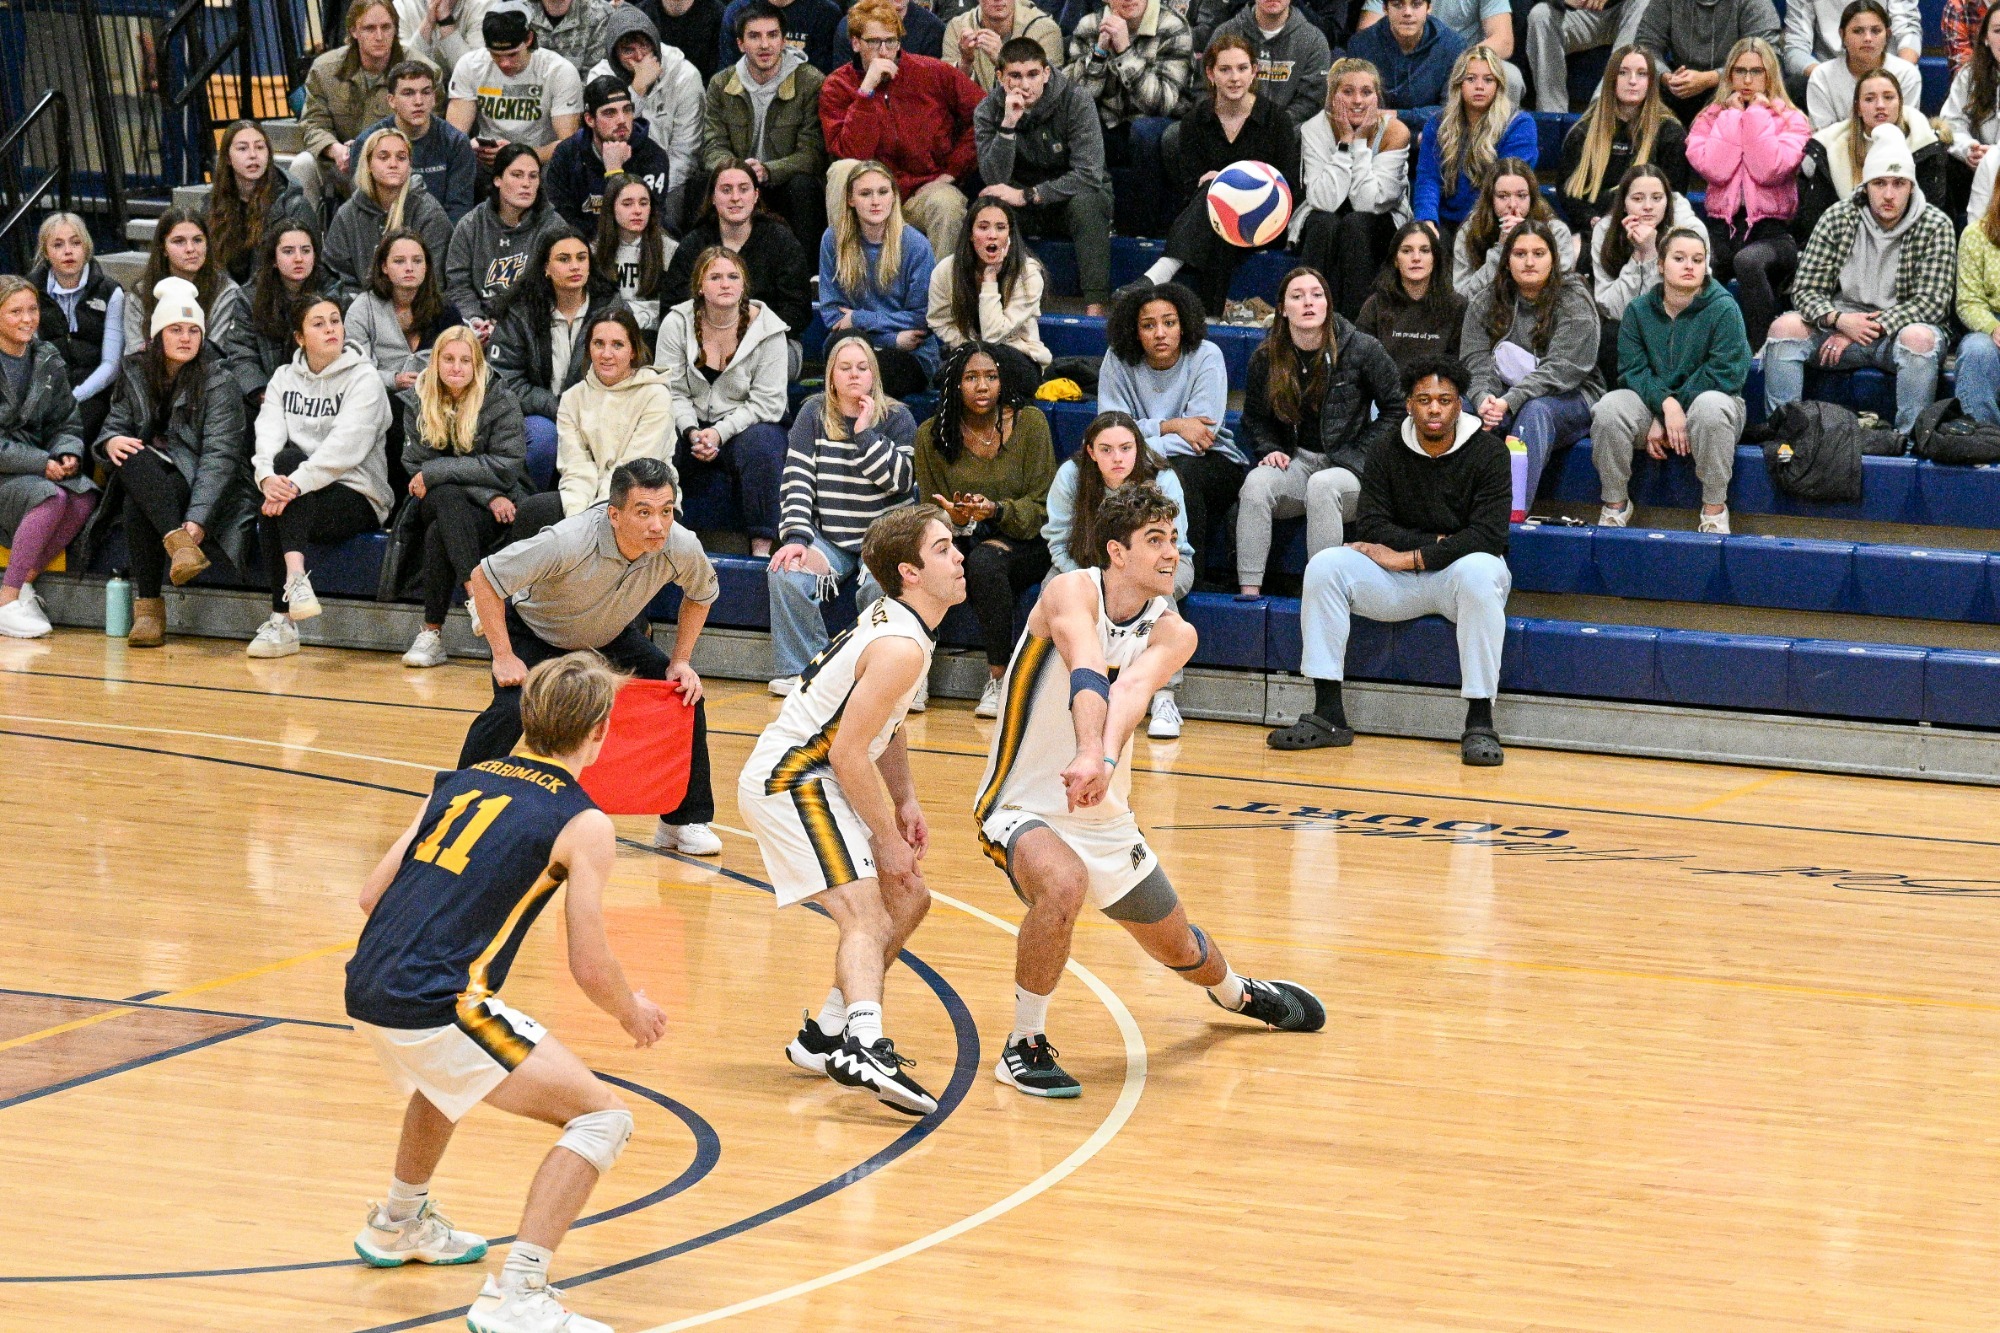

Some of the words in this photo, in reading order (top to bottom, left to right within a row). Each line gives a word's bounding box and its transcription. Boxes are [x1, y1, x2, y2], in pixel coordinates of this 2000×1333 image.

[477, 95, 543, 121] PACKERS
[471, 761, 567, 794] ERRIMACK
[413, 789, 513, 876] 11
[1212, 801, 1570, 839] COURT
